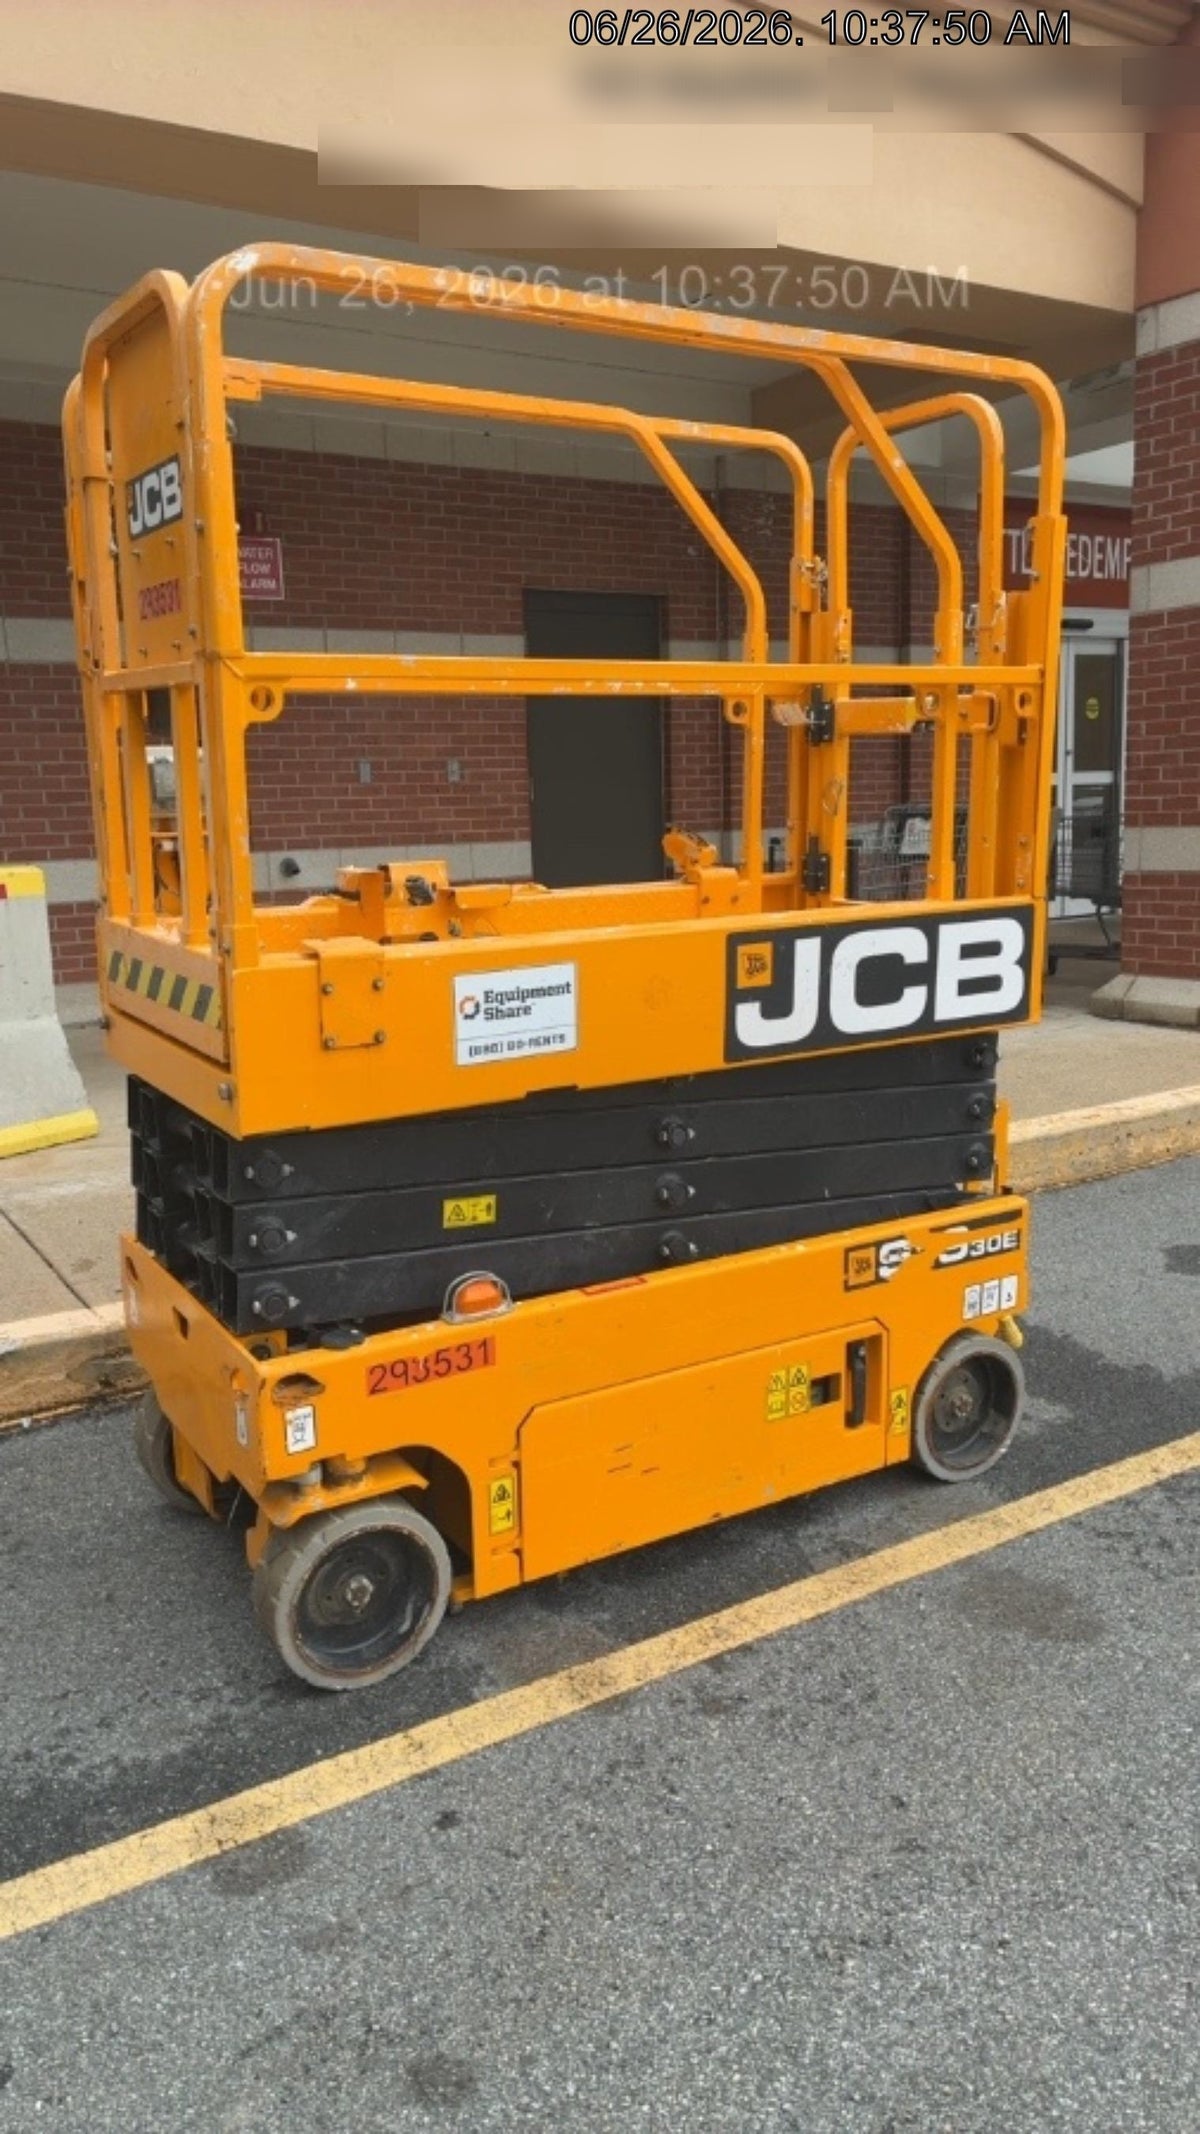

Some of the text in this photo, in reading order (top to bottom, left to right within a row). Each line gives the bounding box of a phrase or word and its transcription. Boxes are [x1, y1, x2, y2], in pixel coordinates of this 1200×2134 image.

[130, 461, 182, 535] JCB
[484, 981, 571, 1005] Equipment
[735, 917, 1026, 1048] JCB
[484, 1003, 531, 1021] Share
[369, 1337, 489, 1395] 293531
